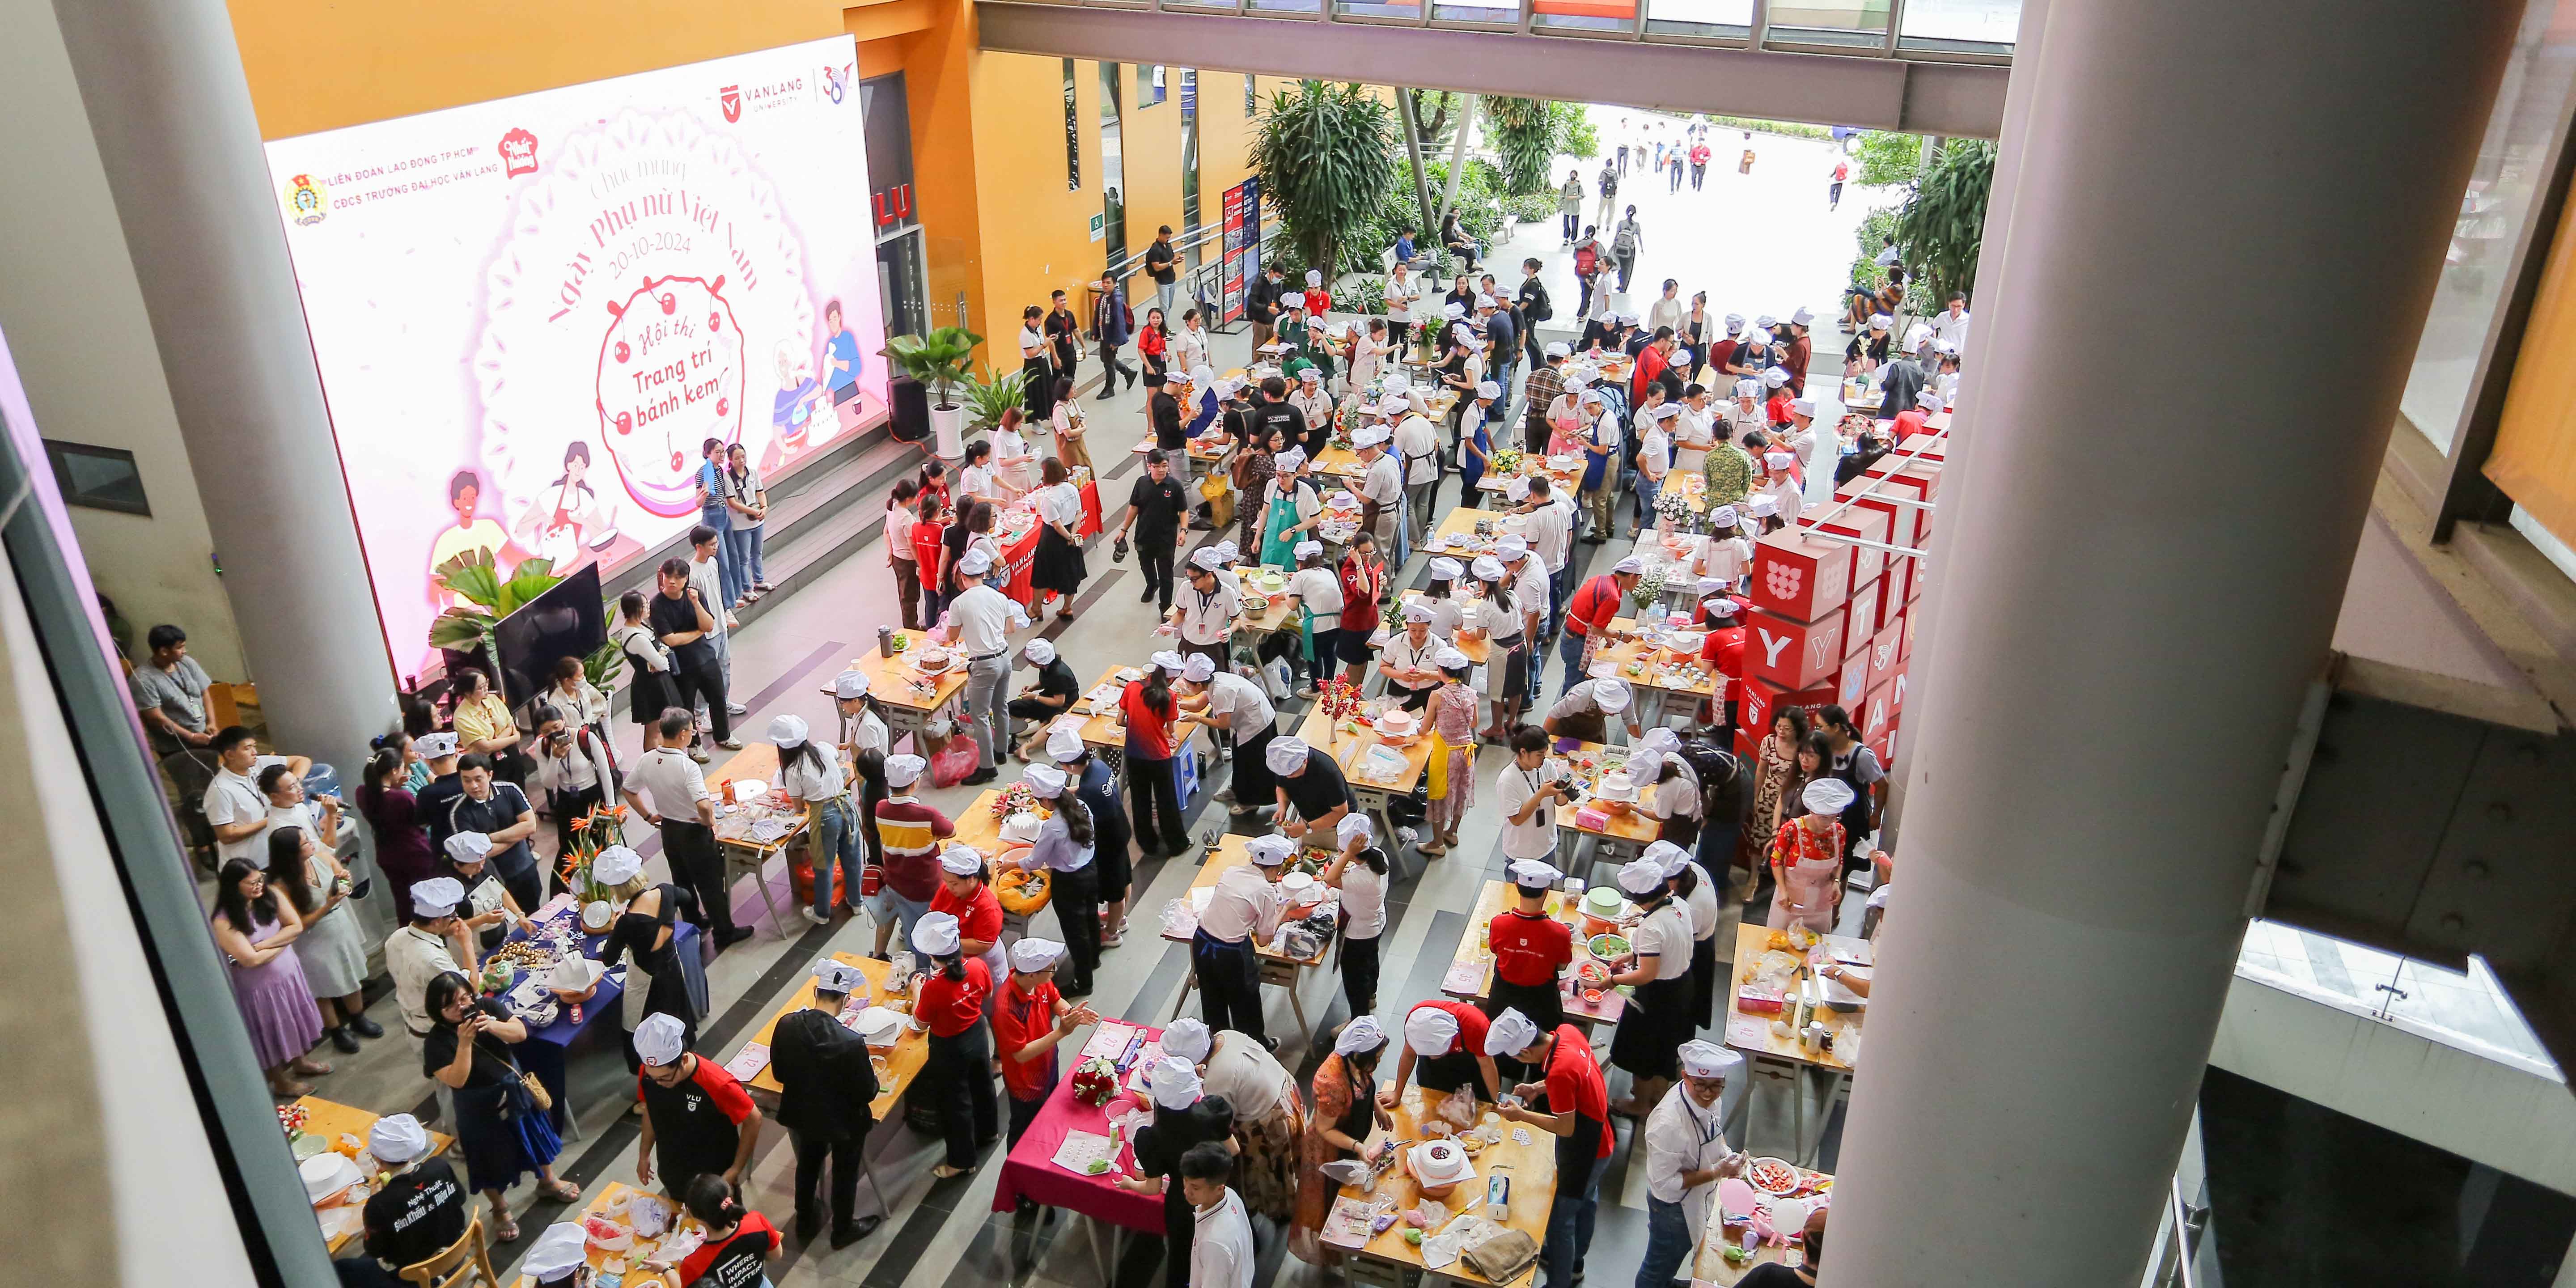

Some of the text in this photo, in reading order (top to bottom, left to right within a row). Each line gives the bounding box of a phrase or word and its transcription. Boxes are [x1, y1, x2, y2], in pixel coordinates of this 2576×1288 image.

[745, 78, 802, 101] VANLANG
[753, 96, 797, 112] UNIVERSITY
[504, 137, 533, 156] Nhất
[328, 171, 352, 186] LIÊN
[355, 164, 384, 181] ĐOÀN
[387, 160, 407, 174] LAO
[333, 193, 362, 209] CĐCS
[365, 183, 408, 201] TRƯỜNG
[475, 164, 498, 177] LANG
[871, 183, 911, 226] LU
[589, 201, 637, 249] Phụ
[609, 232, 691, 280] 20-10-2024
[639, 315, 696, 356] Hội thi
[633, 340, 712, 394] Trang trí
[636, 378, 718, 427] bánh kem
[1015, 558, 1034, 576] UNIVERSIT
[1856, 598, 1871, 637] T
[1757, 627, 1792, 668] Y
[1811, 627, 1836, 669] Y
[1746, 684, 1766, 708] VANLANG
[1867, 698, 1884, 736] A
[1458, 974, 1472, 982] 35
[1102, 1037, 1118, 1048] 27
[1739, 1027, 1754, 1038] 42
[743, 1059, 759, 1068] 12
[686, 1093, 701, 1102] VLU
[407, 1180, 443, 1208] Nghệ Thuật
[726, 1253, 755, 1276] WHERE
[728, 1260, 757, 1284] IMPACT
